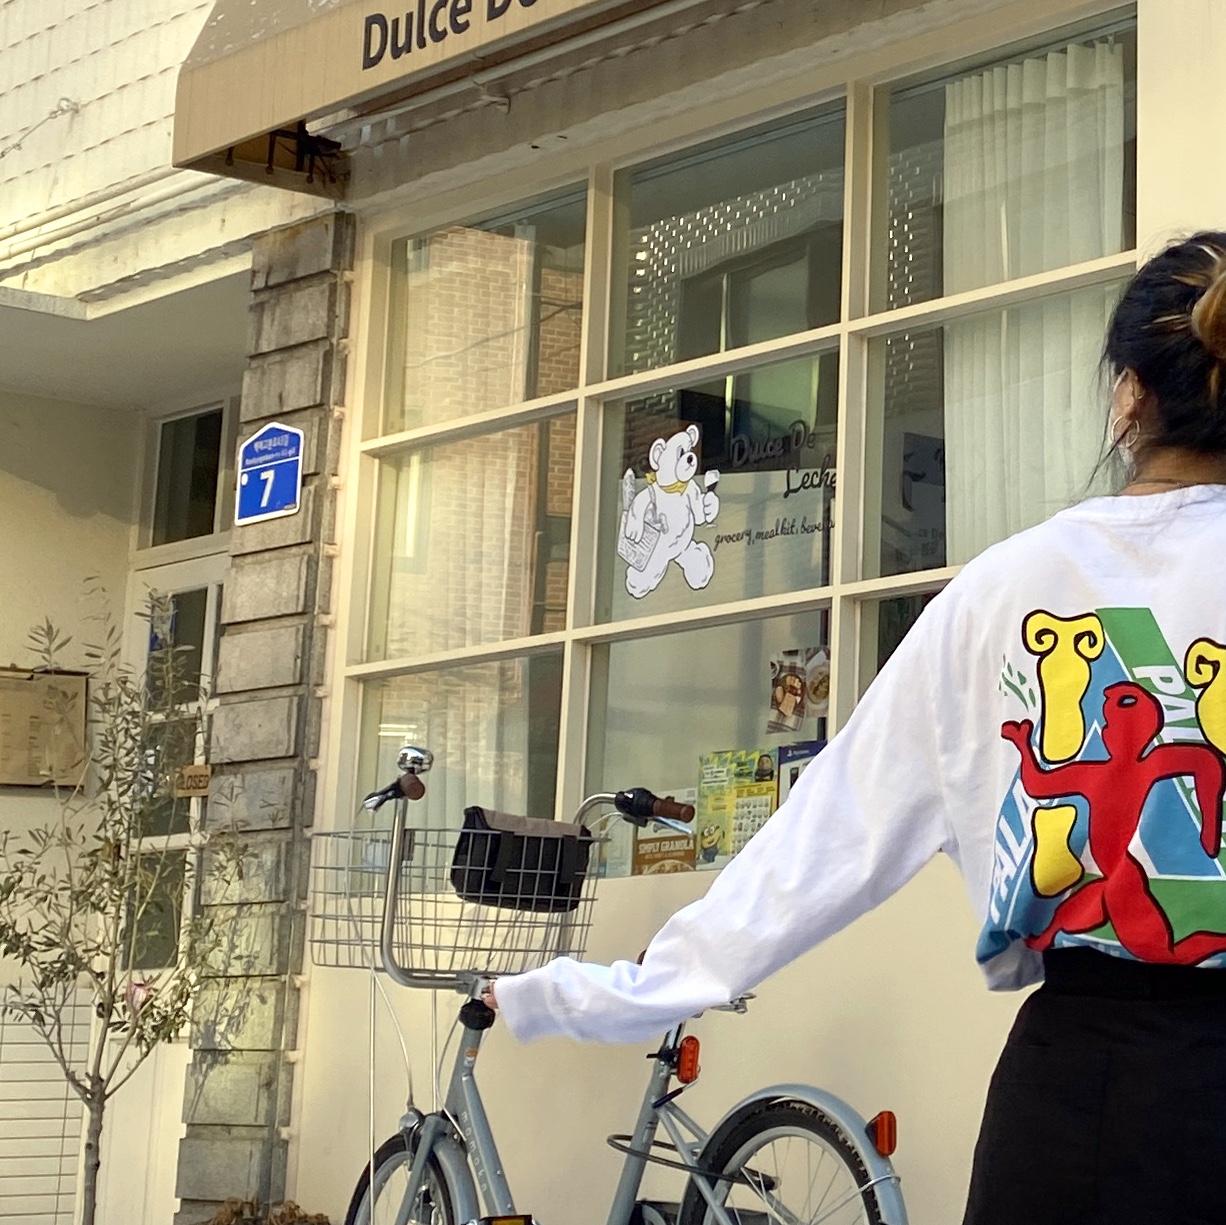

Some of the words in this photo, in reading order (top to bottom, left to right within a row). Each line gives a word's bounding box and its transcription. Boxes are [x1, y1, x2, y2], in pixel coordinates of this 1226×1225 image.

[362, 0, 472, 71] Dulce
[730, 423, 784, 468] Dulce
[788, 420, 817, 449] De
[260, 469, 275, 508] 7
